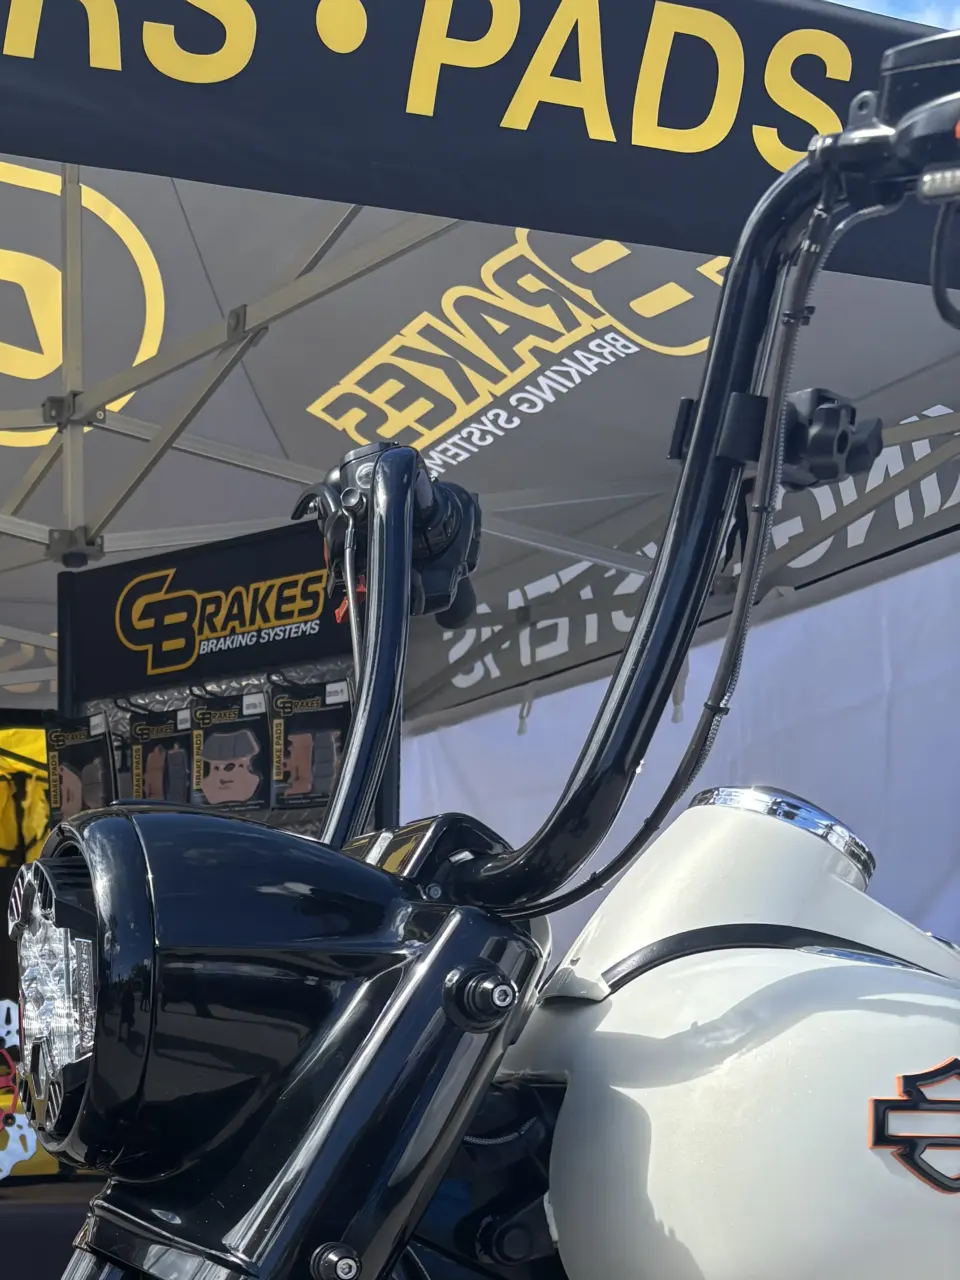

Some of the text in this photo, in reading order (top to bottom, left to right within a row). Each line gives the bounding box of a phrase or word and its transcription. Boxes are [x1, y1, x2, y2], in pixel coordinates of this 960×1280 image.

[404, 0, 853, 174] PADS
[199, 619, 320, 655] BRAKING SYSTEMS
